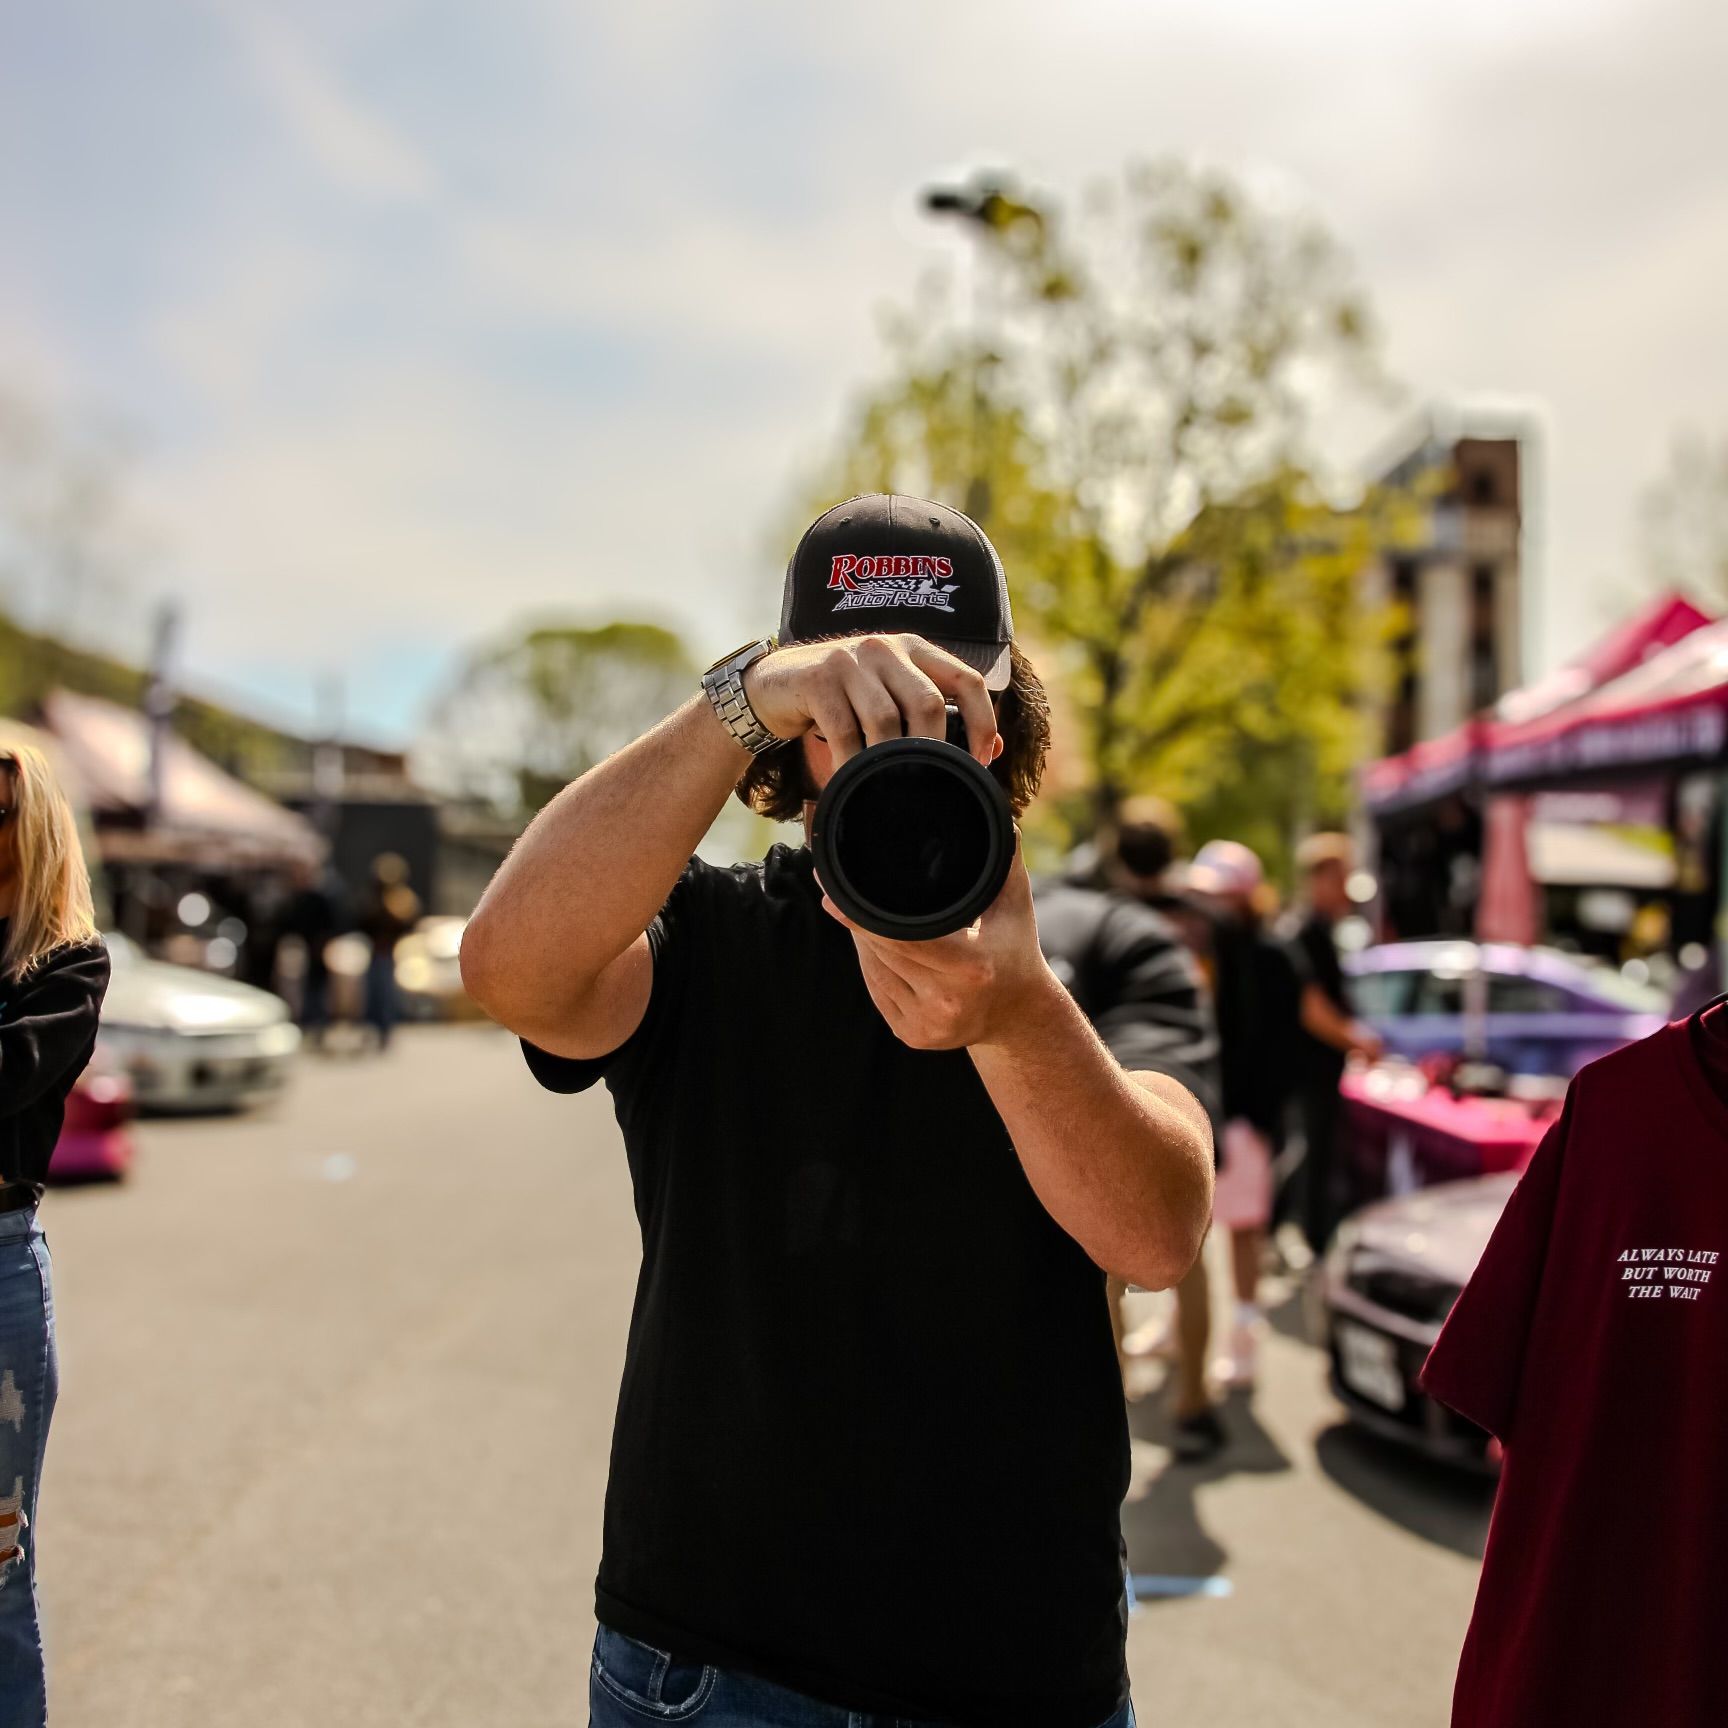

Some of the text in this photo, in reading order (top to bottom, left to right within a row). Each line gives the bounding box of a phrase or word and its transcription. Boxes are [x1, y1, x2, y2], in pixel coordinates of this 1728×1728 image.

[827, 554, 953, 591] ROBBINS
[834, 591, 950, 610] Auto Parts
[1617, 1249, 1719, 1264] ALWAYS LATE
[1621, 1267, 1711, 1282] BUT WORTH
[1628, 1286, 1701, 1300] THE WAIT
